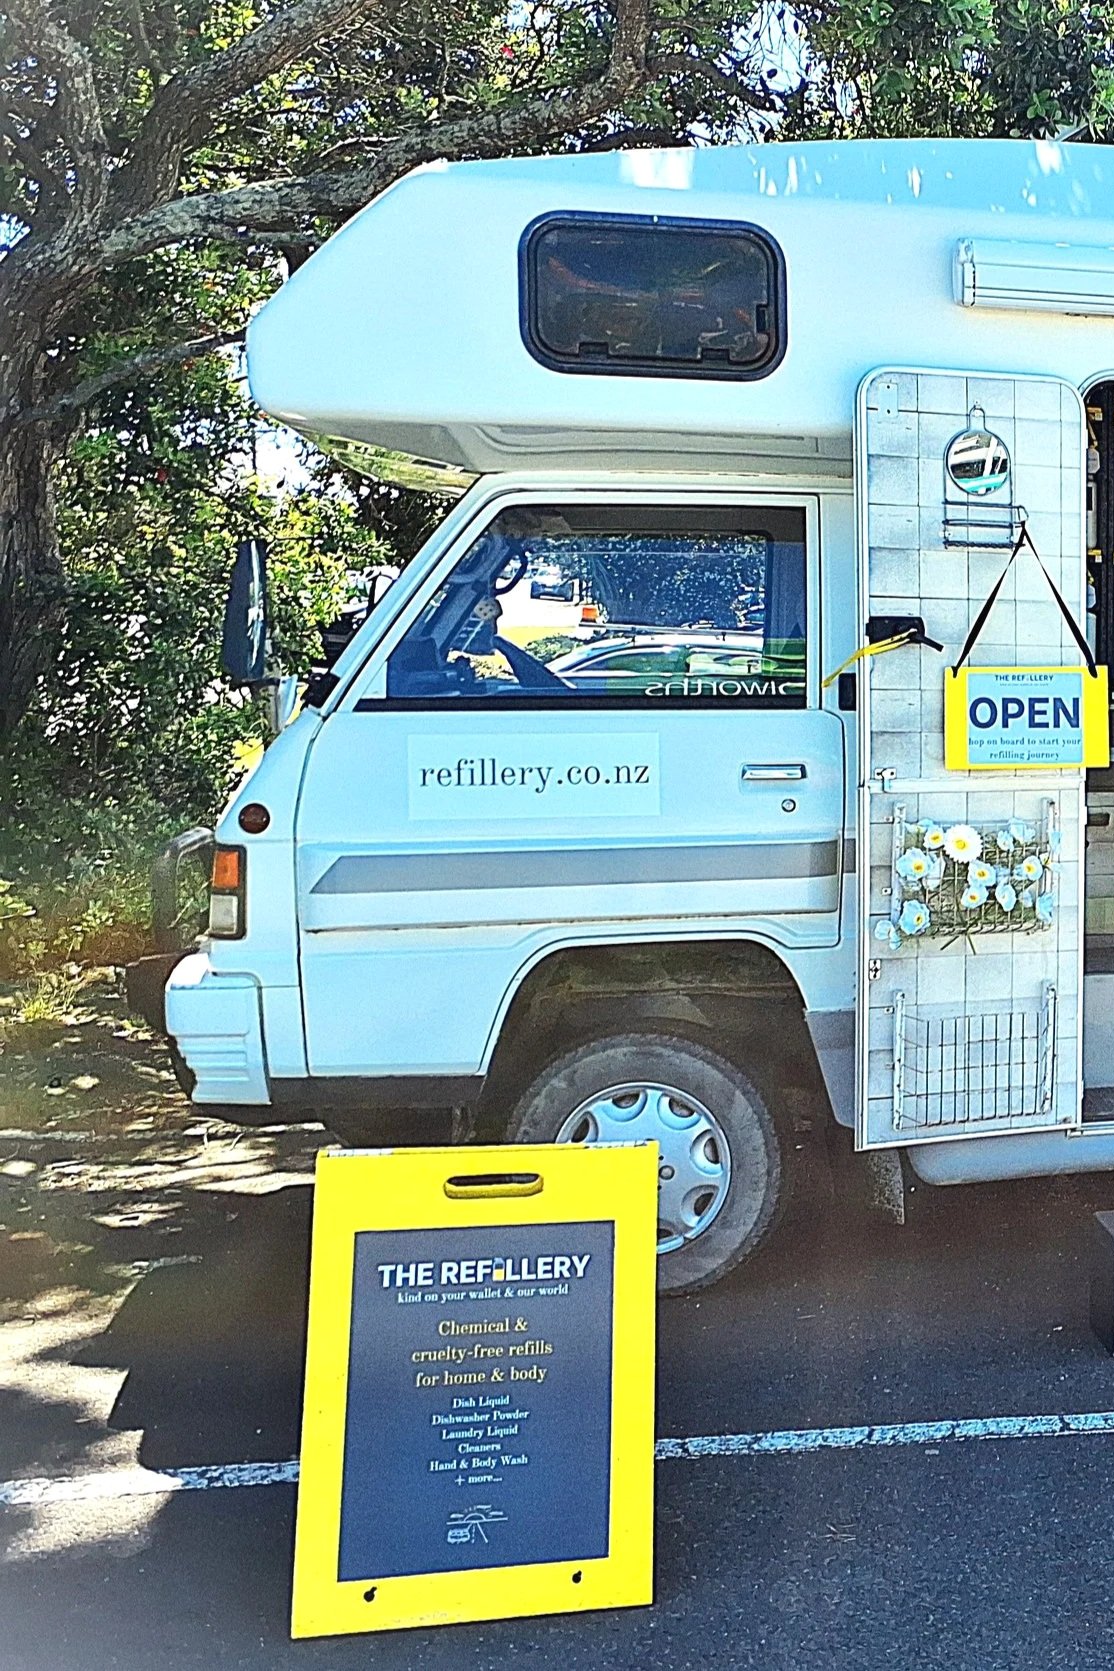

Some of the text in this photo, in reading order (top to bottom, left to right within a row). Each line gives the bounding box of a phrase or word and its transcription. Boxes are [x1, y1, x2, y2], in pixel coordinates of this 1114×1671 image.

[994, 674, 1010, 682] THE
[969, 697, 1080, 729] OPEN
[968, 737, 984, 746] hop
[1000, 737, 1025, 746] board
[1027, 738, 1036, 746] to
[1039, 737, 1059, 746] start
[1062, 738, 1081, 747] your
[989, 750, 1060, 761] refilling journey
[419, 758, 650, 793] refillery.co.nz
[378, 1262, 434, 1288] THE
[398, 1284, 569, 1304] kind on your wallet & our world
[438, 1316, 529, 1336] Chemical &
[411, 1340, 554, 1364] cruelty-free refills
[416, 1365, 548, 1388] for home & body
[453, 1395, 510, 1409] Dish Liquid
[432, 1409, 530, 1426] Dishwasher Powder
[442, 1425, 518, 1441] Laundry Liquid
[457, 1443, 502, 1454] Cleaners
[430, 1454, 528, 1472] Hand & Body Wash
[454, 1475, 466, 1486] +
